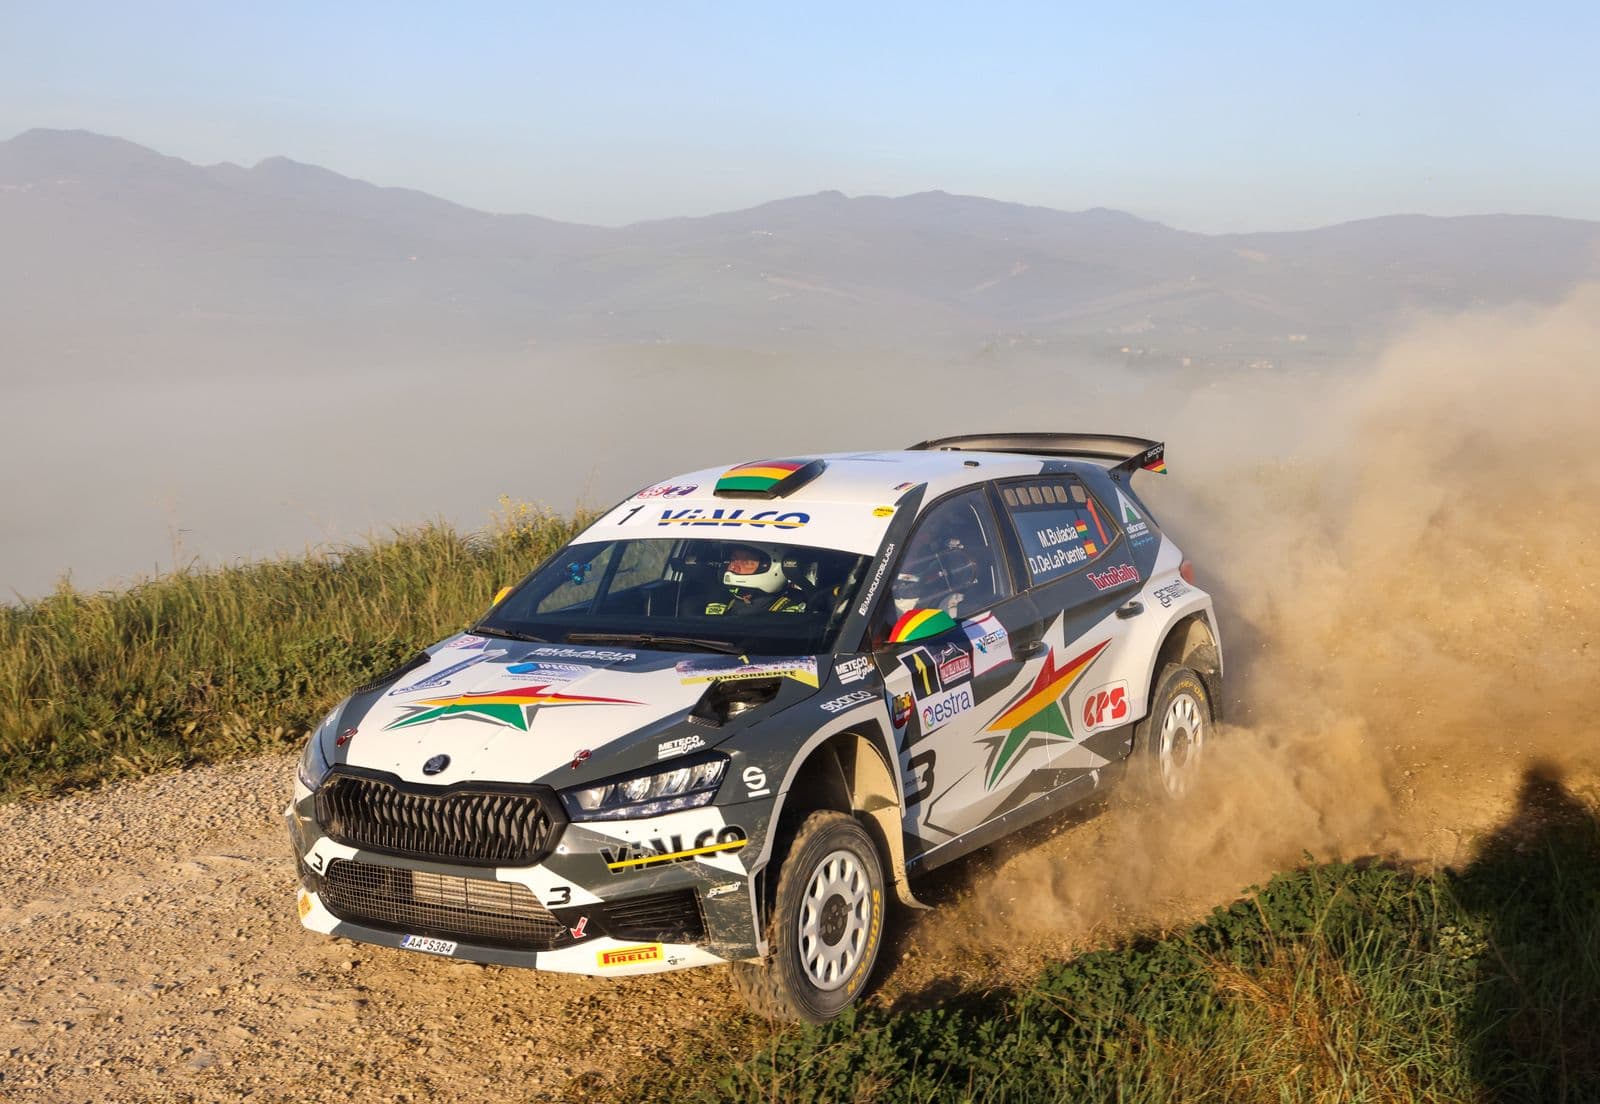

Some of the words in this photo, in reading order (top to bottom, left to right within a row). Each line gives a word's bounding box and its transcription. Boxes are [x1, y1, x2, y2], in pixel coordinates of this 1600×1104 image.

[618, 505, 645, 525] 1
[835, 656, 868, 675] METECO
[912, 652, 932, 696] 1
[706, 670, 797, 682] CONCORRENTE
[934, 691, 971, 722] estra
[658, 735, 700, 753] METECO
[546, 886, 571, 906] 3
[603, 946, 658, 965] PIRELLI
